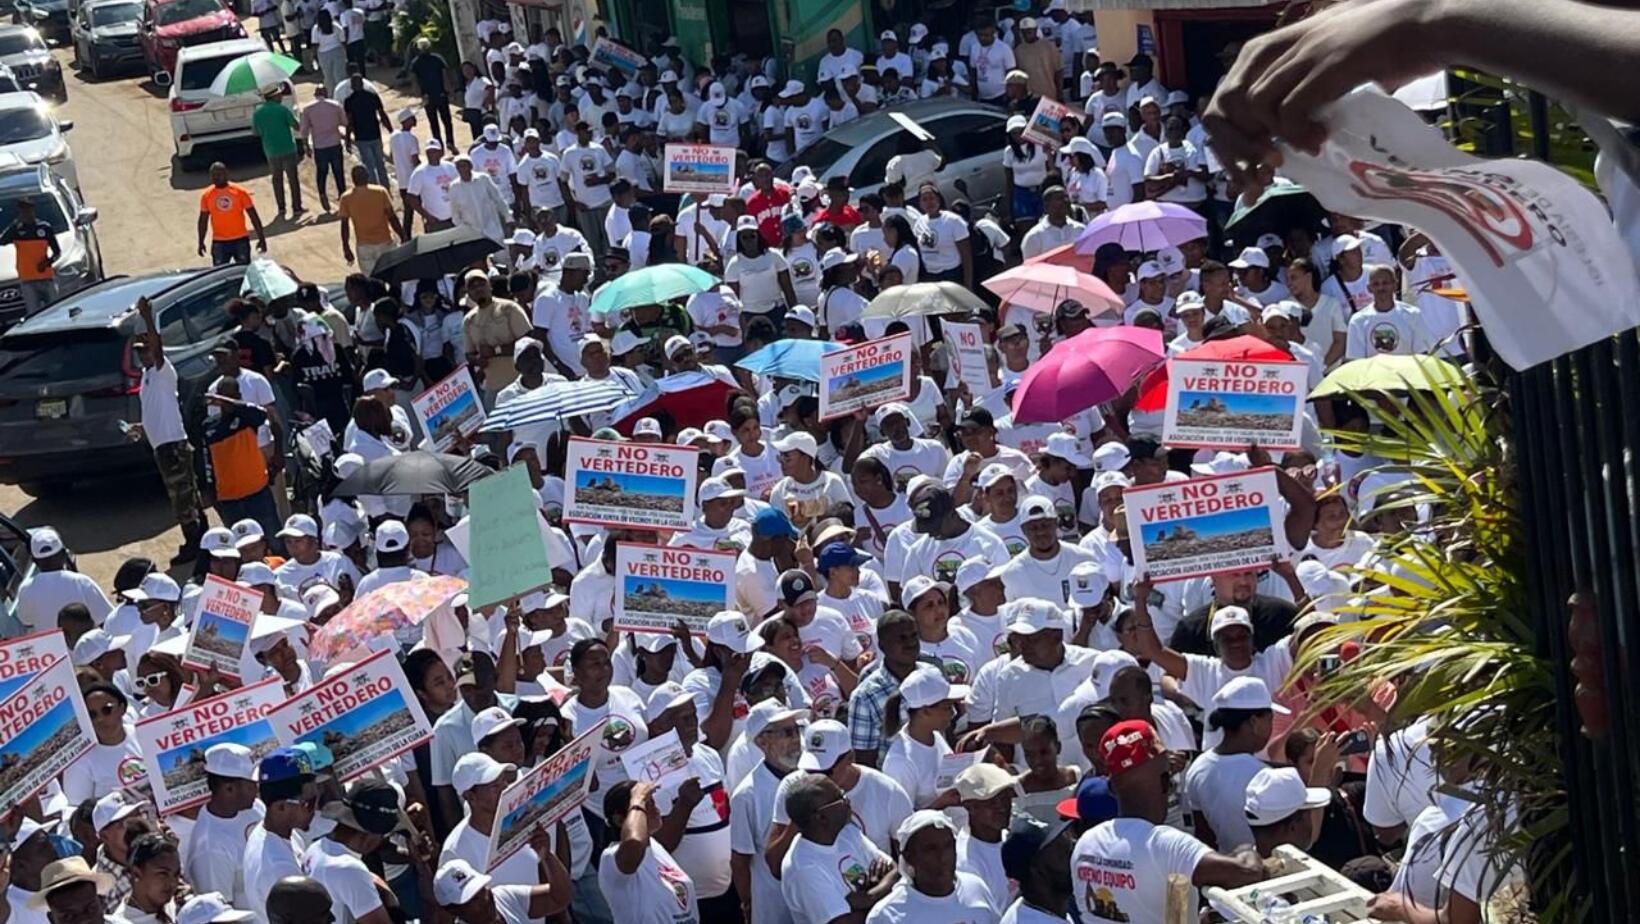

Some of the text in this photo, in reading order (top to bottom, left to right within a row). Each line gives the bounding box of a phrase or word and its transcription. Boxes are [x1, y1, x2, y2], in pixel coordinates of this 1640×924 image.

[673, 154, 728, 164] VERTEDERO
[960, 331, 976, 346] NO
[856, 346, 878, 359] NO
[831, 350, 902, 376] VERTEDERO
[1224, 365, 1257, 378] NO
[436, 383, 450, 395] NO
[1183, 377, 1295, 394] VERTEDERO
[423, 381, 469, 417] VERTEDERO
[617, 447, 648, 460] NO
[580, 457, 684, 477] VERTEDERO
[1182, 483, 1218, 500] NO
[1141, 492, 1264, 522] VERTEDERO
[662, 552, 690, 565] NO
[627, 562, 724, 582] VERTEDERO
[225, 590, 240, 604] NO
[206, 598, 252, 622] VERTEDERO
[316, 681, 348, 706] NO
[0, 686, 65, 744] TEDERO
[1, 695, 28, 724] NO
[193, 702, 229, 722] NO
[288, 676, 392, 736] VERTEDERO
[156, 703, 273, 750] VERTEDERO
[540, 754, 566, 778] NO
[508, 746, 592, 812] VERTEDERO
[1103, 870, 1136, 890] EQUIPO
